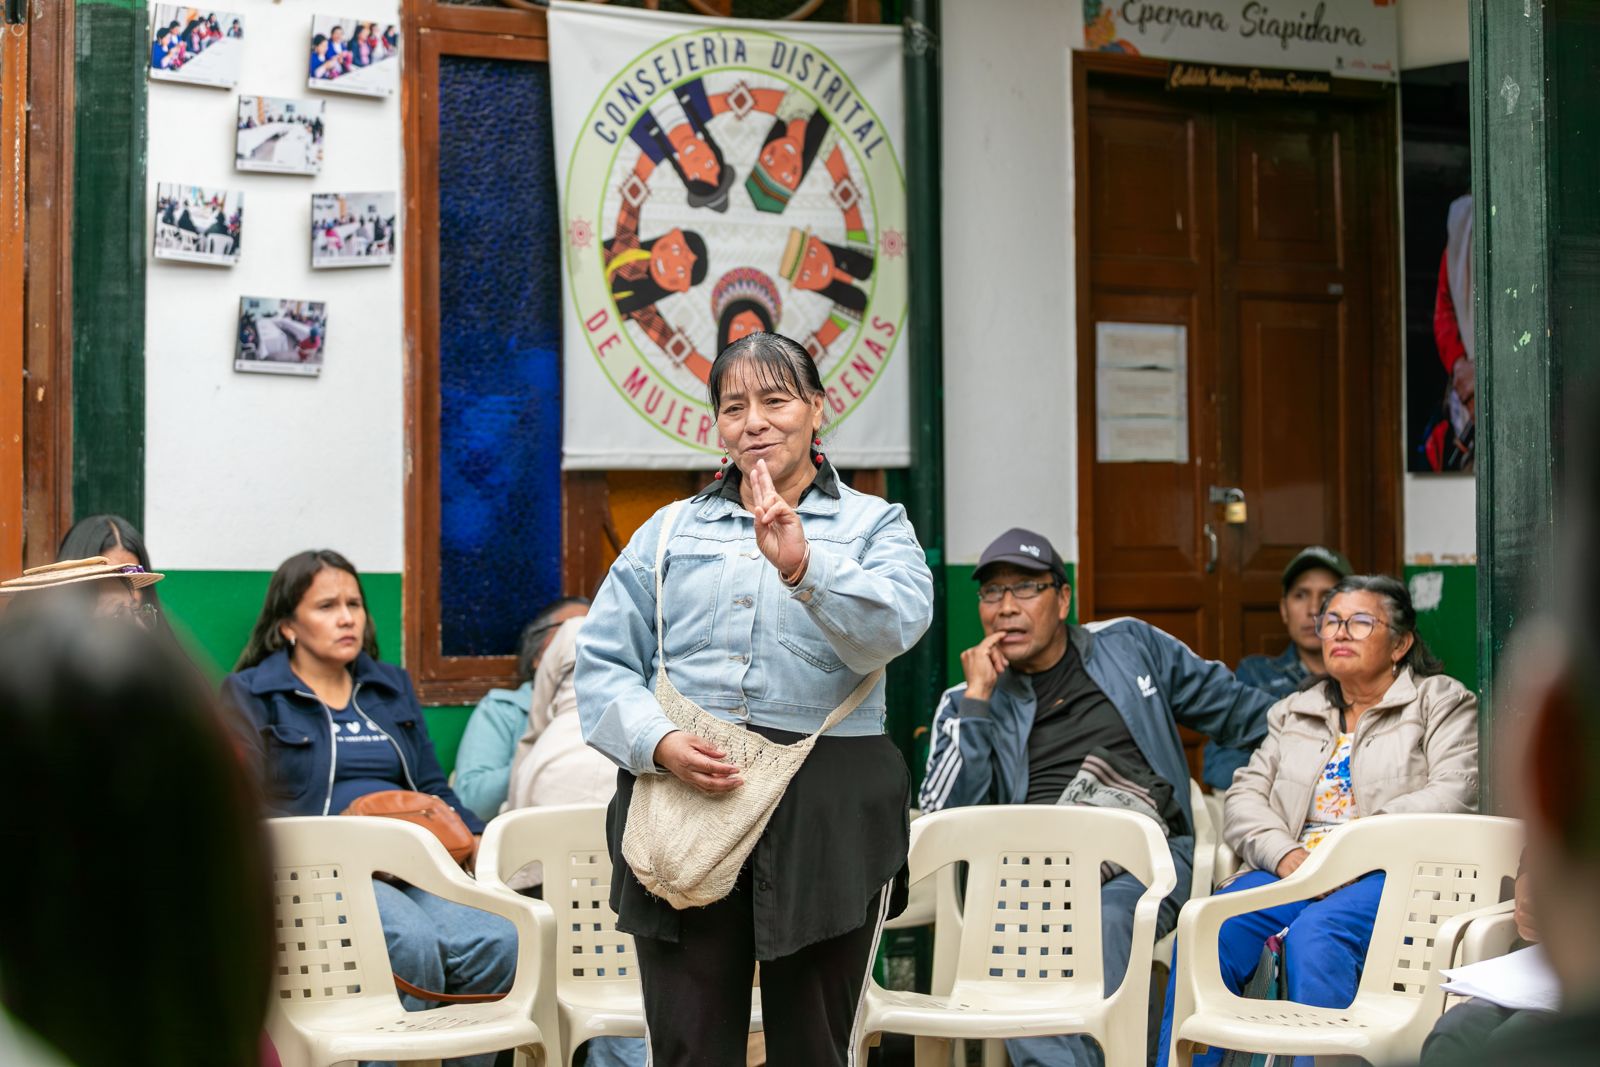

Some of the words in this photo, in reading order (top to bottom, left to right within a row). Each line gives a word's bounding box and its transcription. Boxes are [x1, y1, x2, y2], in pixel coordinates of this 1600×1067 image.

[1239, 0, 1365, 50] Siapidara
[771, 41, 885, 160] DISTRITAL
[586, 308, 622, 359] DE
[623, 367, 726, 449] MUJER
[826, 316, 896, 415] GENAS
